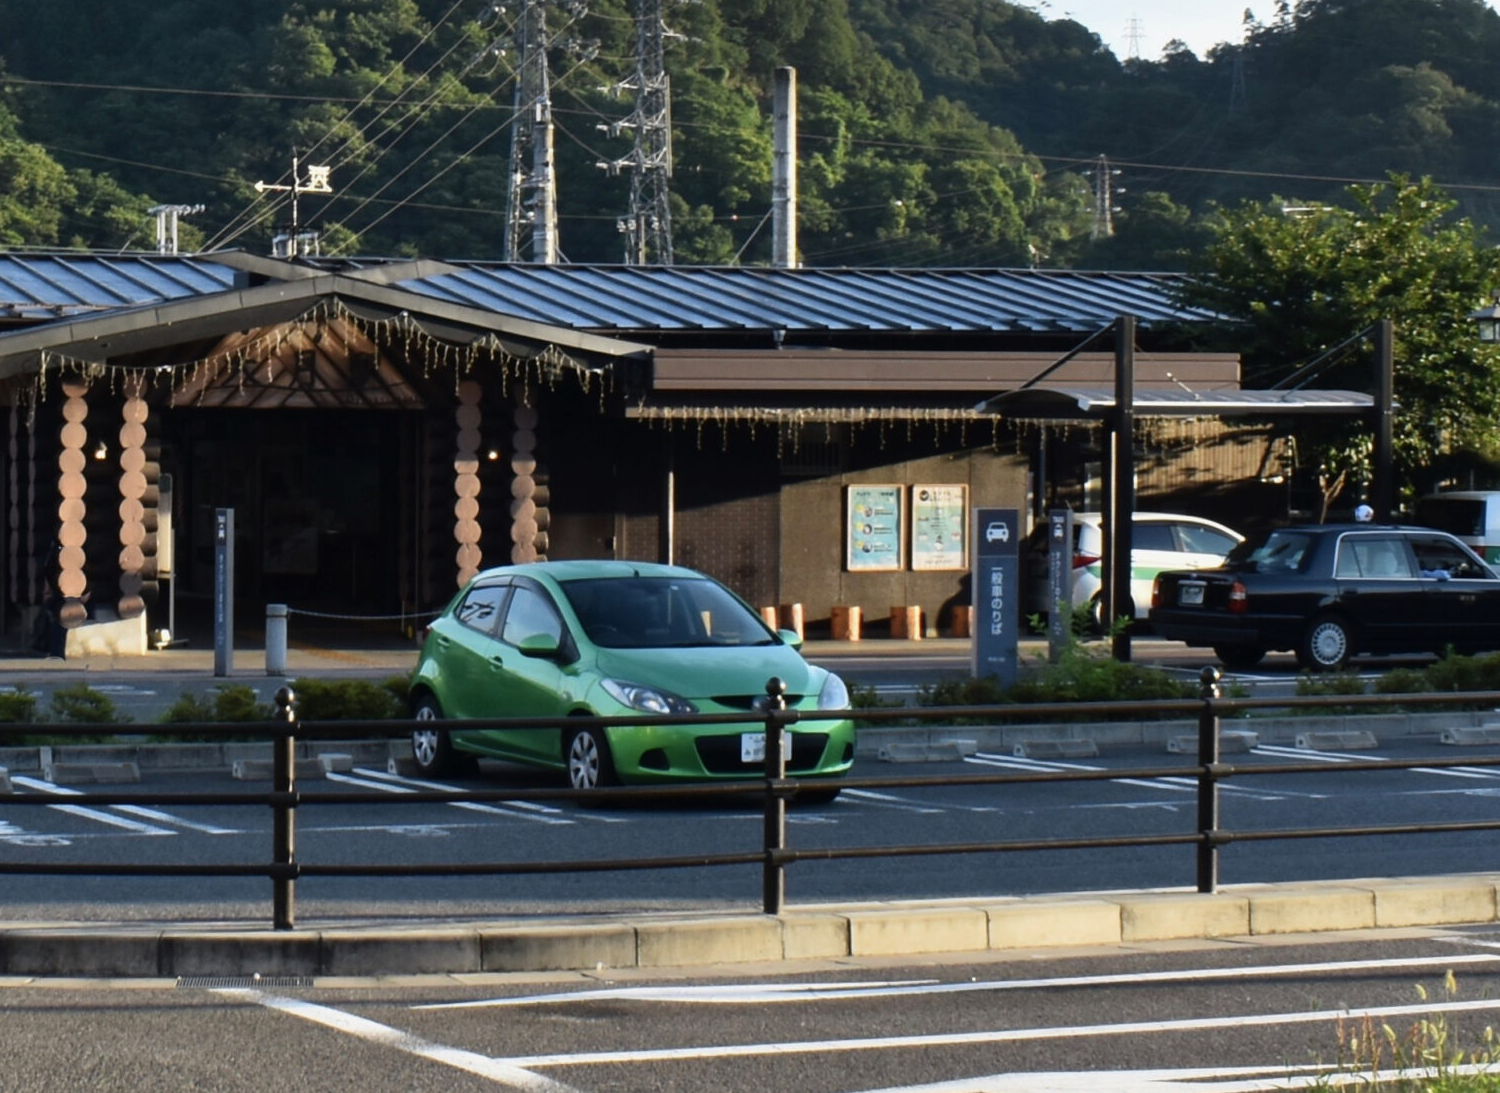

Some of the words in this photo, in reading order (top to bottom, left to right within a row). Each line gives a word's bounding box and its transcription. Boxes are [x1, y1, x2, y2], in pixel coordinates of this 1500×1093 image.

[990, 566, 1003, 636] 一般車のりば
